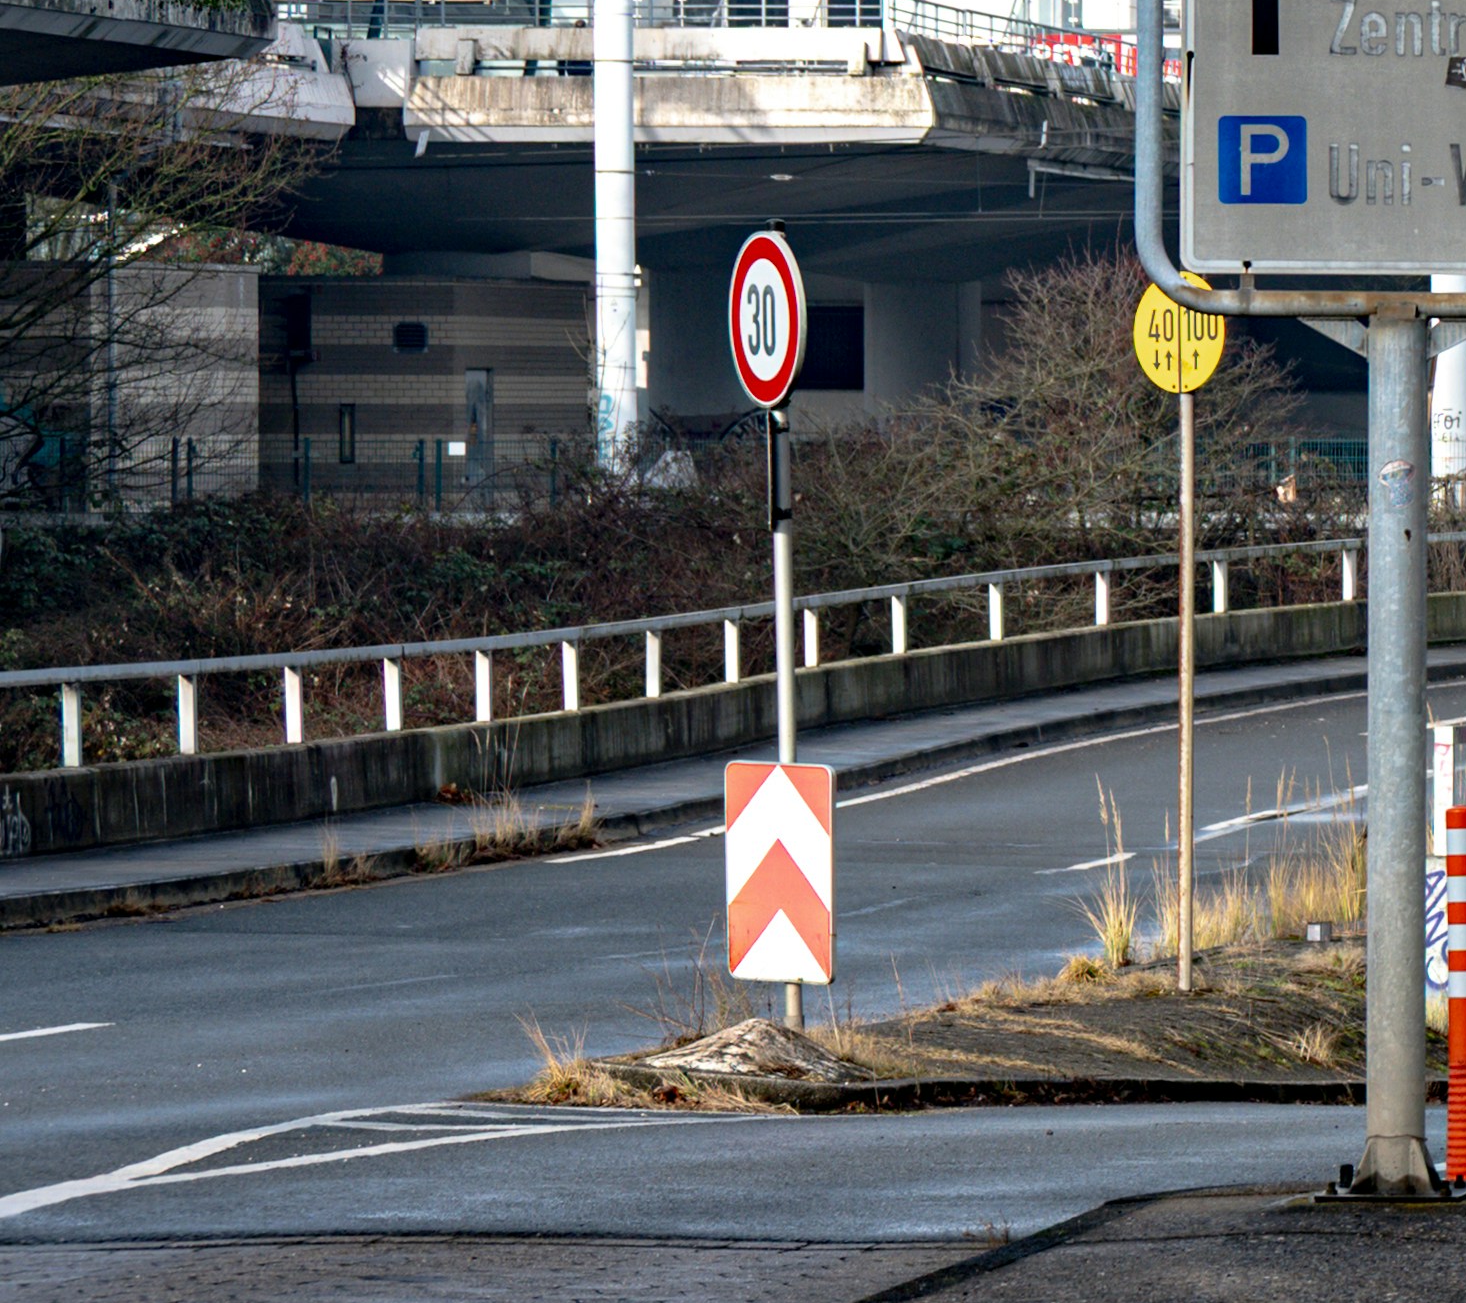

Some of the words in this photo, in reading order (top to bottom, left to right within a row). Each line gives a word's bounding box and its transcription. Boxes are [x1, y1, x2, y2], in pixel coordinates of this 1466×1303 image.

[1240, 124, 1290, 196] P
[747, 283, 776, 357] 30
[1148, 309, 1174, 342] 40
[1183, 308, 1218, 341] 100
